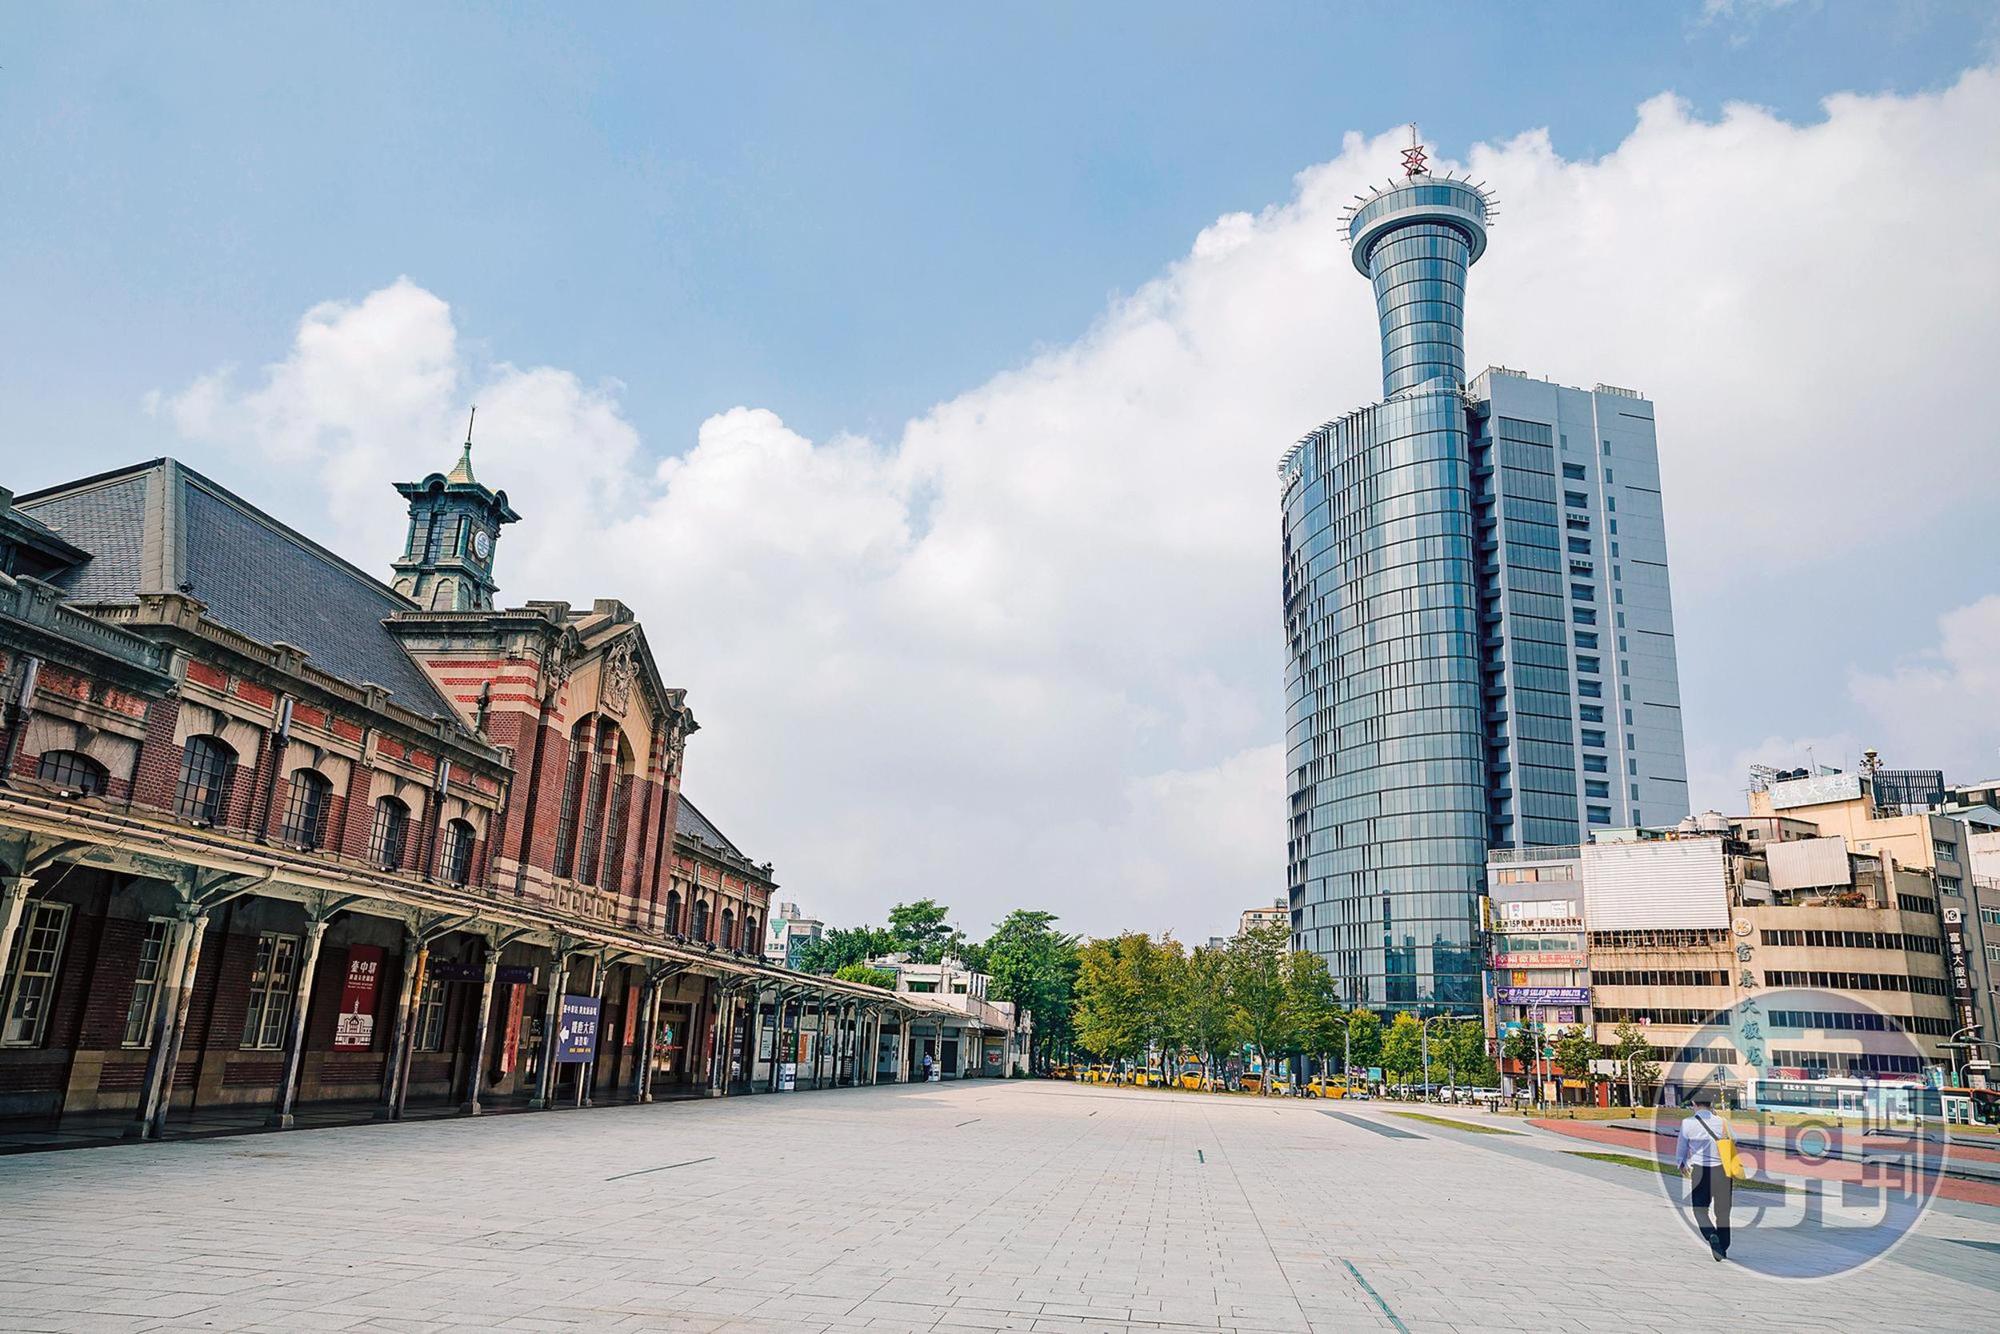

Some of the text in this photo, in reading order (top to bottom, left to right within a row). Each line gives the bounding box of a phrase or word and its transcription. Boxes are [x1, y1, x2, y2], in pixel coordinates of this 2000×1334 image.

[1736, 942, 1764, 1067] 富春大飯店
[1949, 932, 1967, 989] 富春大飯店
